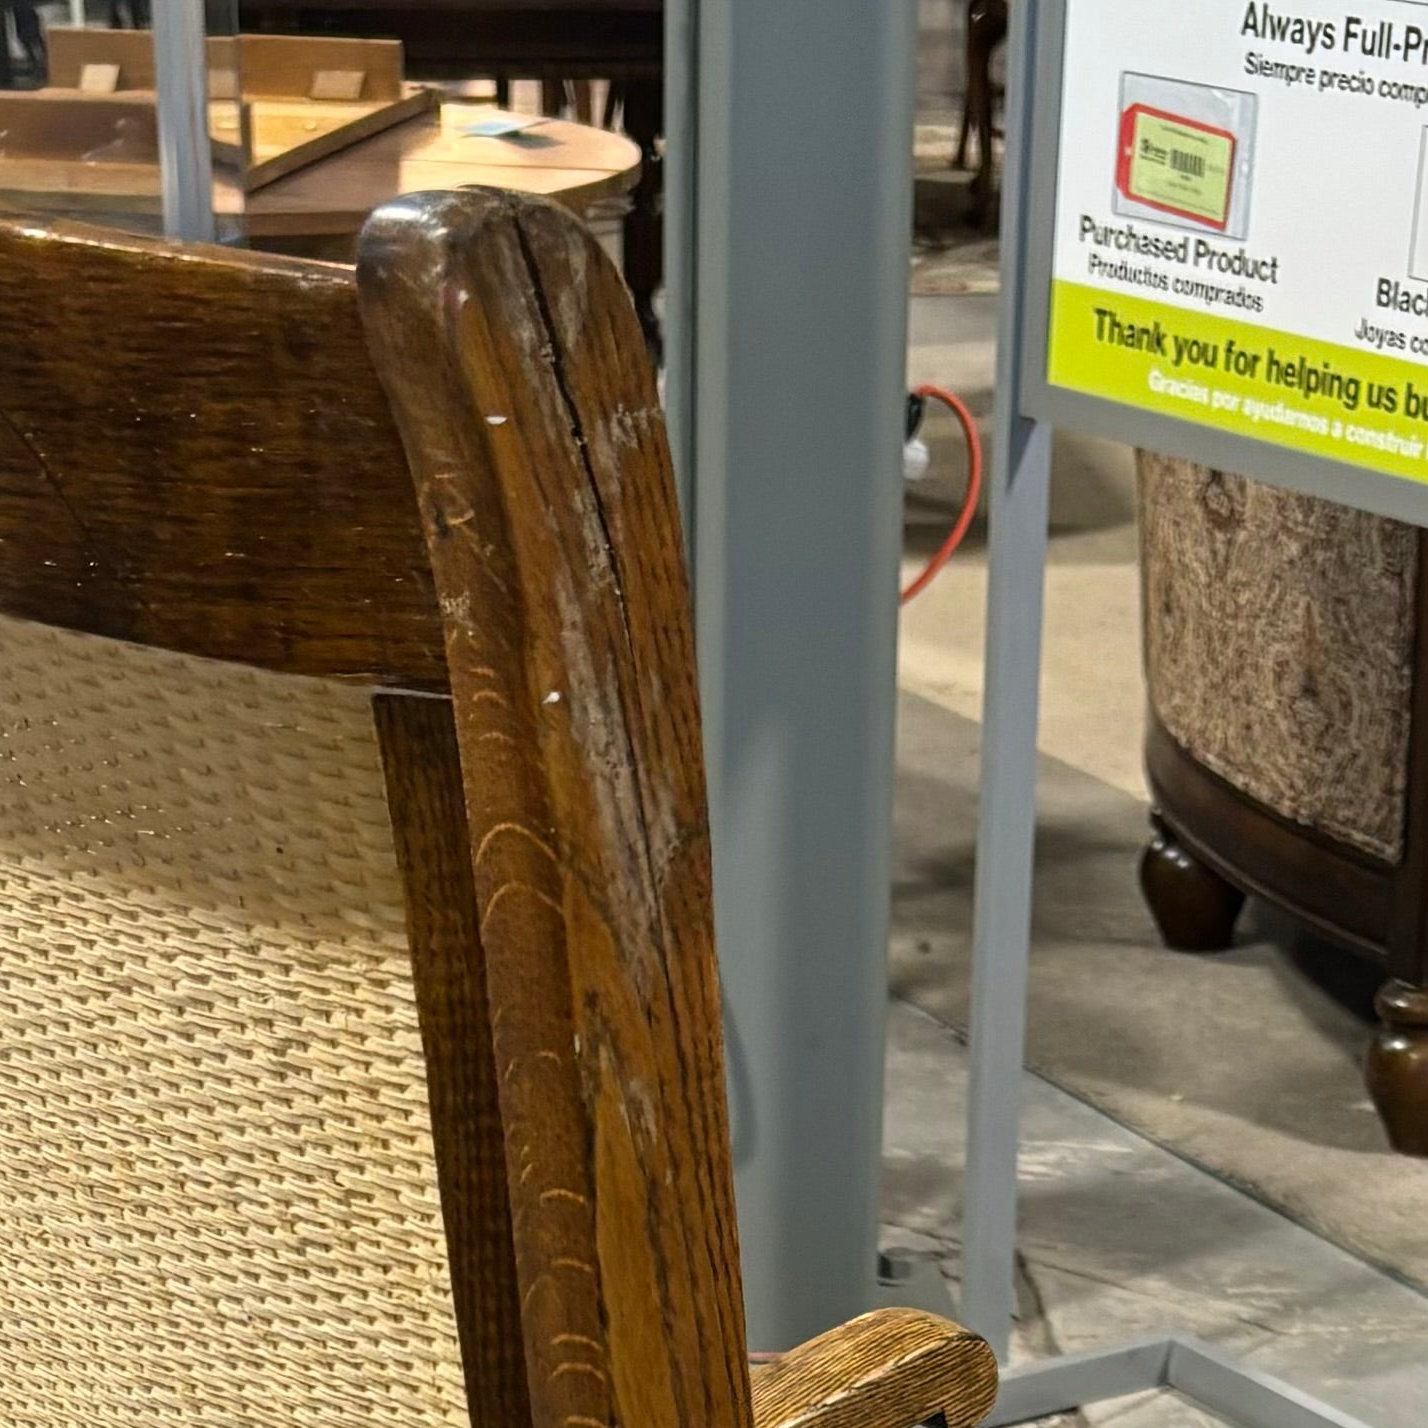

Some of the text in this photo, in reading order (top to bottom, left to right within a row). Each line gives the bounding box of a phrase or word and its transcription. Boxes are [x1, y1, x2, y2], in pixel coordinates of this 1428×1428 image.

[1241, 1, 1335, 54] Always
[1244, 51, 1315, 86] Siempre
[1319, 69, 1374, 95] precio
[1079, 214, 1279, 284] Purchased Product
[1094, 307, 1167, 357] Thank
[1172, 334, 1217, 368] you
[1223, 339, 1261, 379] for
[1266, 348, 1361, 411] helping
[1367, 382, 1397, 413] us
[1355, 317, 1406, 350] Joyas
